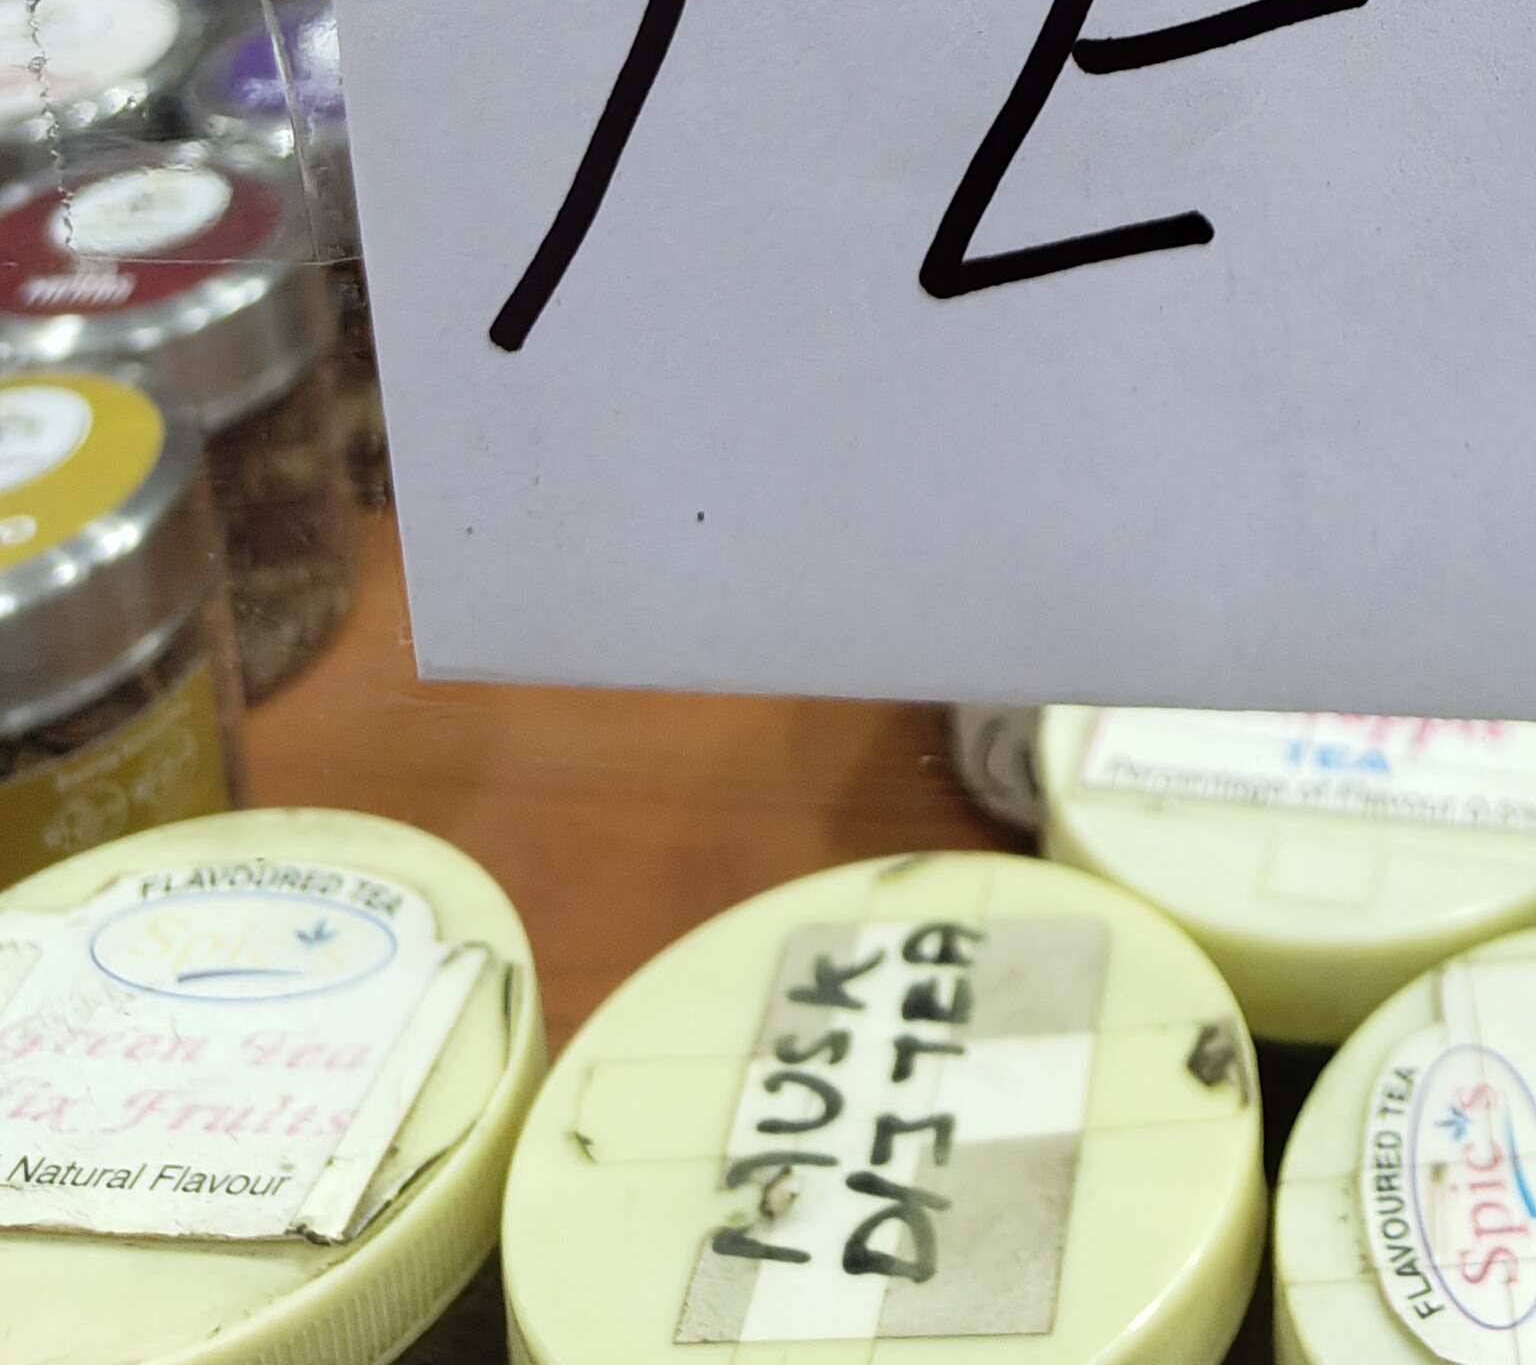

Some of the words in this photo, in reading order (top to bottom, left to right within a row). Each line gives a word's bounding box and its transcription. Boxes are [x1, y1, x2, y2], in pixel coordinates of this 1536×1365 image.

[139, 862, 344, 901] FLAVOURED
[351, 878, 405, 918] TEA
[239, 1031, 373, 1070] Tea
[100, 1087, 352, 1137] Fruits
[1378, 1065, 1420, 1117] TEA
[6, 1155, 148, 1191] Natural
[149, 1162, 293, 1198] Flavour
[1374, 1129, 1446, 1320] FLAVOURED
